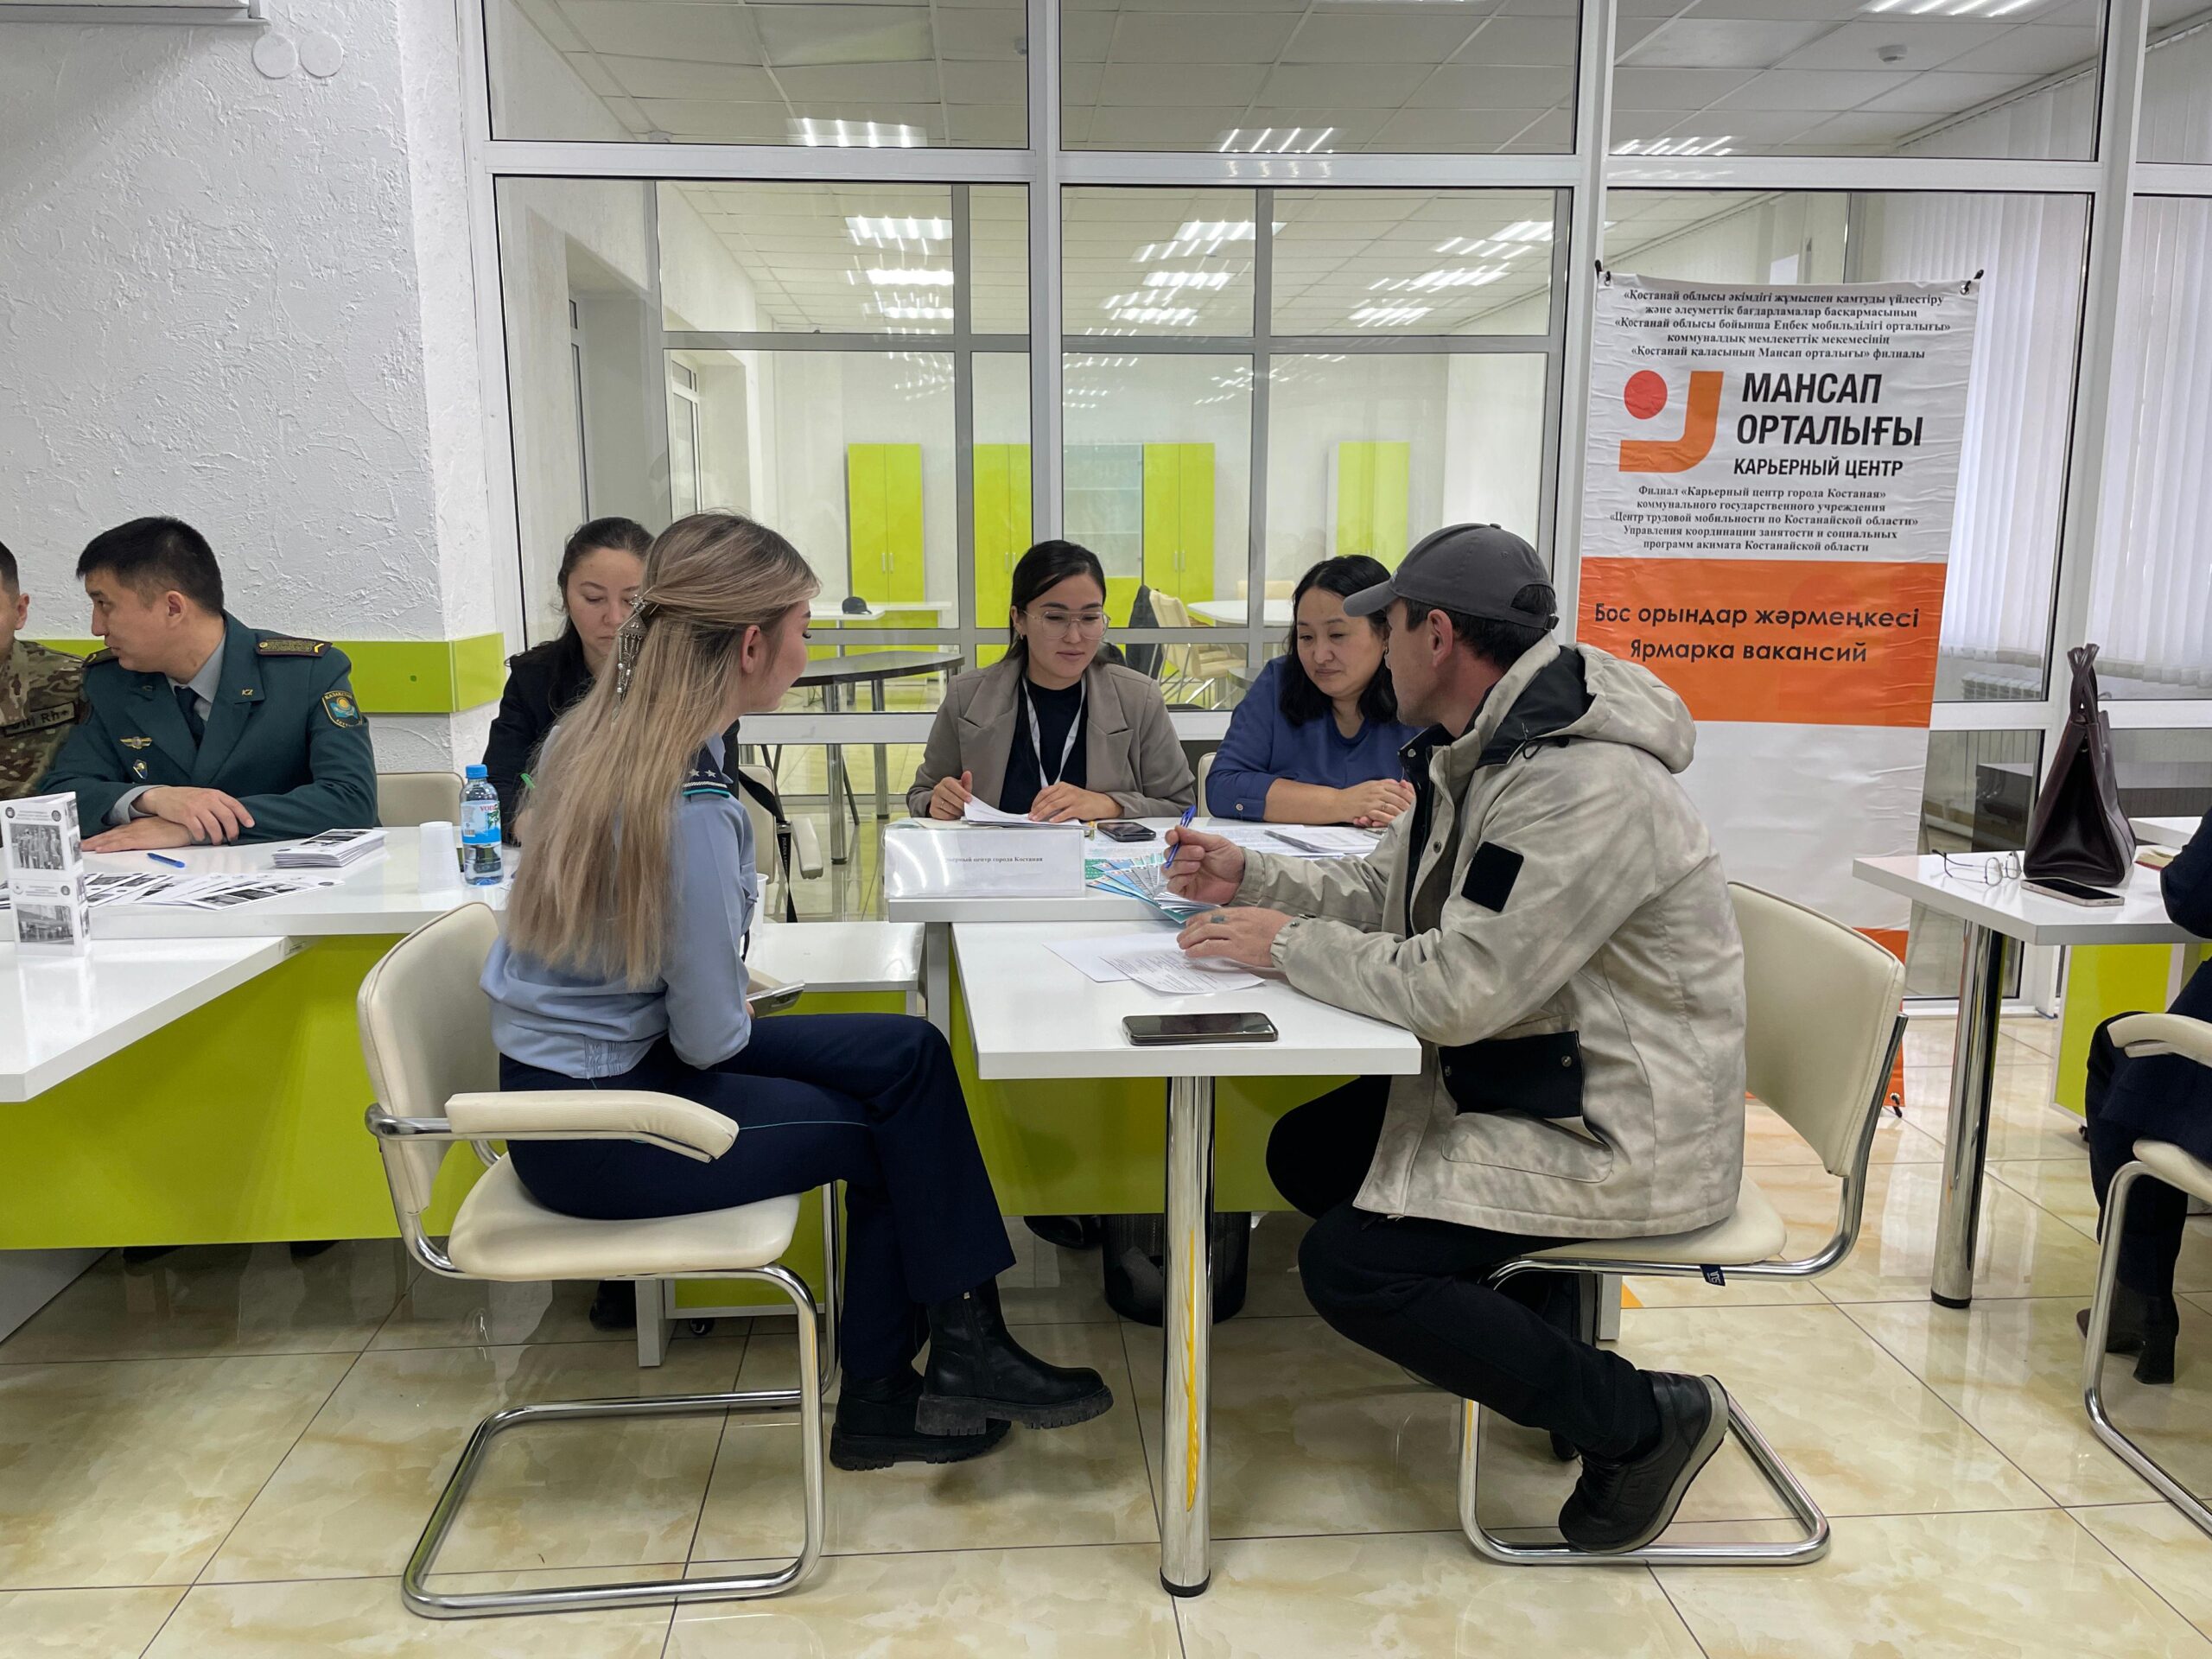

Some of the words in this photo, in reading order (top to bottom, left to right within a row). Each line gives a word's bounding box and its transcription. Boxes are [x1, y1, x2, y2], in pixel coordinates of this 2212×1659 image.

[1682, 291, 1726, 302] облысы
[1728, 291, 1773, 302] әкімдігі
[1836, 295, 1885, 306] қамтуды
[1675, 306, 1734, 316] әлеуметтік
[1673, 319, 1716, 329] облысы
[1719, 319, 1770, 330] бойынша
[1667, 334, 1746, 344] коммуналдық
[1748, 334, 1819, 344] мемлекеттік
[1758, 347, 1802, 358] Мансап
[1872, 348, 1925, 360] филиалы
[1742, 372, 1883, 404] МАНСАП
[1737, 414, 1923, 446] ОРТАЛЫҒЫ
[1733, 456, 1840, 475] КАРЬЕРНЫЙ
[1845, 460, 1904, 479] ЦЕНТР
[1638, 486, 1678, 496] Филиал
[1752, 489, 1784, 499] центр
[1787, 489, 1823, 499] города
[1637, 500, 1717, 511] коммунального
[1719, 502, 1815, 512] государственного
[1817, 504, 1886, 513] учреждения
[1646, 512, 1692, 524] трудовой
[1694, 513, 1765, 524] мобильности
[1784, 514, 1862, 525] Костанайской
[1624, 525, 1682, 537] Управления
[1685, 527, 1757, 538] координации
[1759, 529, 1814, 537] занятости
[1827, 530, 1897, 539] социальных
[1643, 540, 1694, 550] программ
[1745, 540, 1821, 551] Костанайской
[1824, 542, 1869, 552] области
[1594, 602, 1630, 622] Бос
[1637, 605, 1747, 628] орындар
[1754, 607, 1920, 629] жәрмеңкесі
[1630, 639, 1734, 663] Ярмарка
[1742, 642, 1867, 663] вакансий
